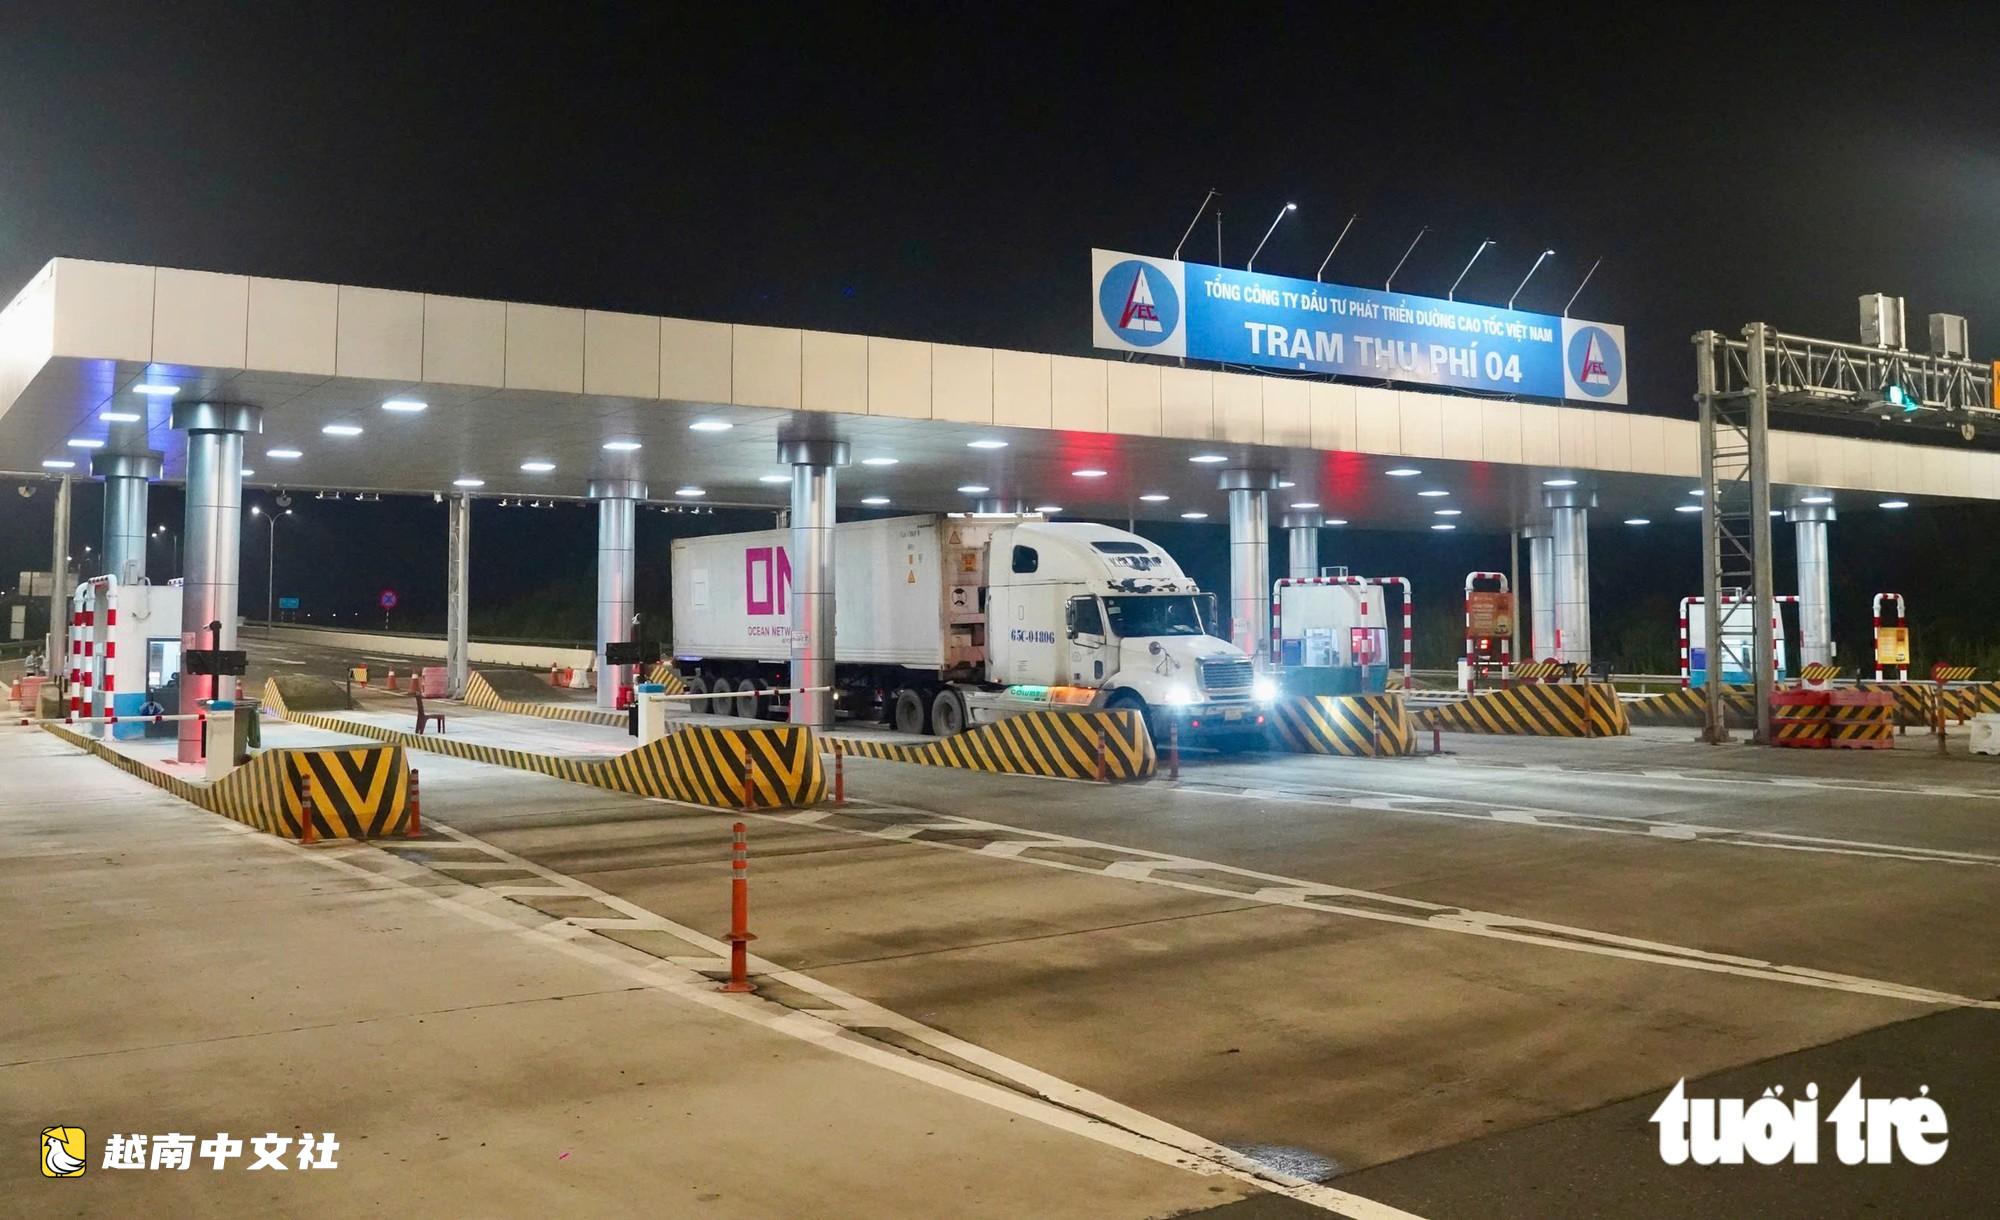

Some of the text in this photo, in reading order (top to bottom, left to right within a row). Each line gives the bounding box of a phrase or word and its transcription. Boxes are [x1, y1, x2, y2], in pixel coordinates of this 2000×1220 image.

[1204, 273, 1241, 301] TỔNG
[1244, 284, 1280, 307] CÔNG
[1282, 291, 1299, 309] TY
[1300, 288, 1328, 313] ĐẦU
[1330, 298, 1347, 316] TƯ
[1350, 299, 1379, 321] PHÁT
[1382, 299, 1414, 325] TRIỂN
[1458, 316, 1481, 333] CAO
[1482, 314, 1504, 337] TỐC
[1506, 320, 1527, 344] VIỆT
[1529, 327, 1553, 344] NAM
[1244, 321, 1523, 384] TRẠM THU PHÍ 04
[745, 546, 792, 616] ON
[747, 626, 791, 637] OCEAN NETW
